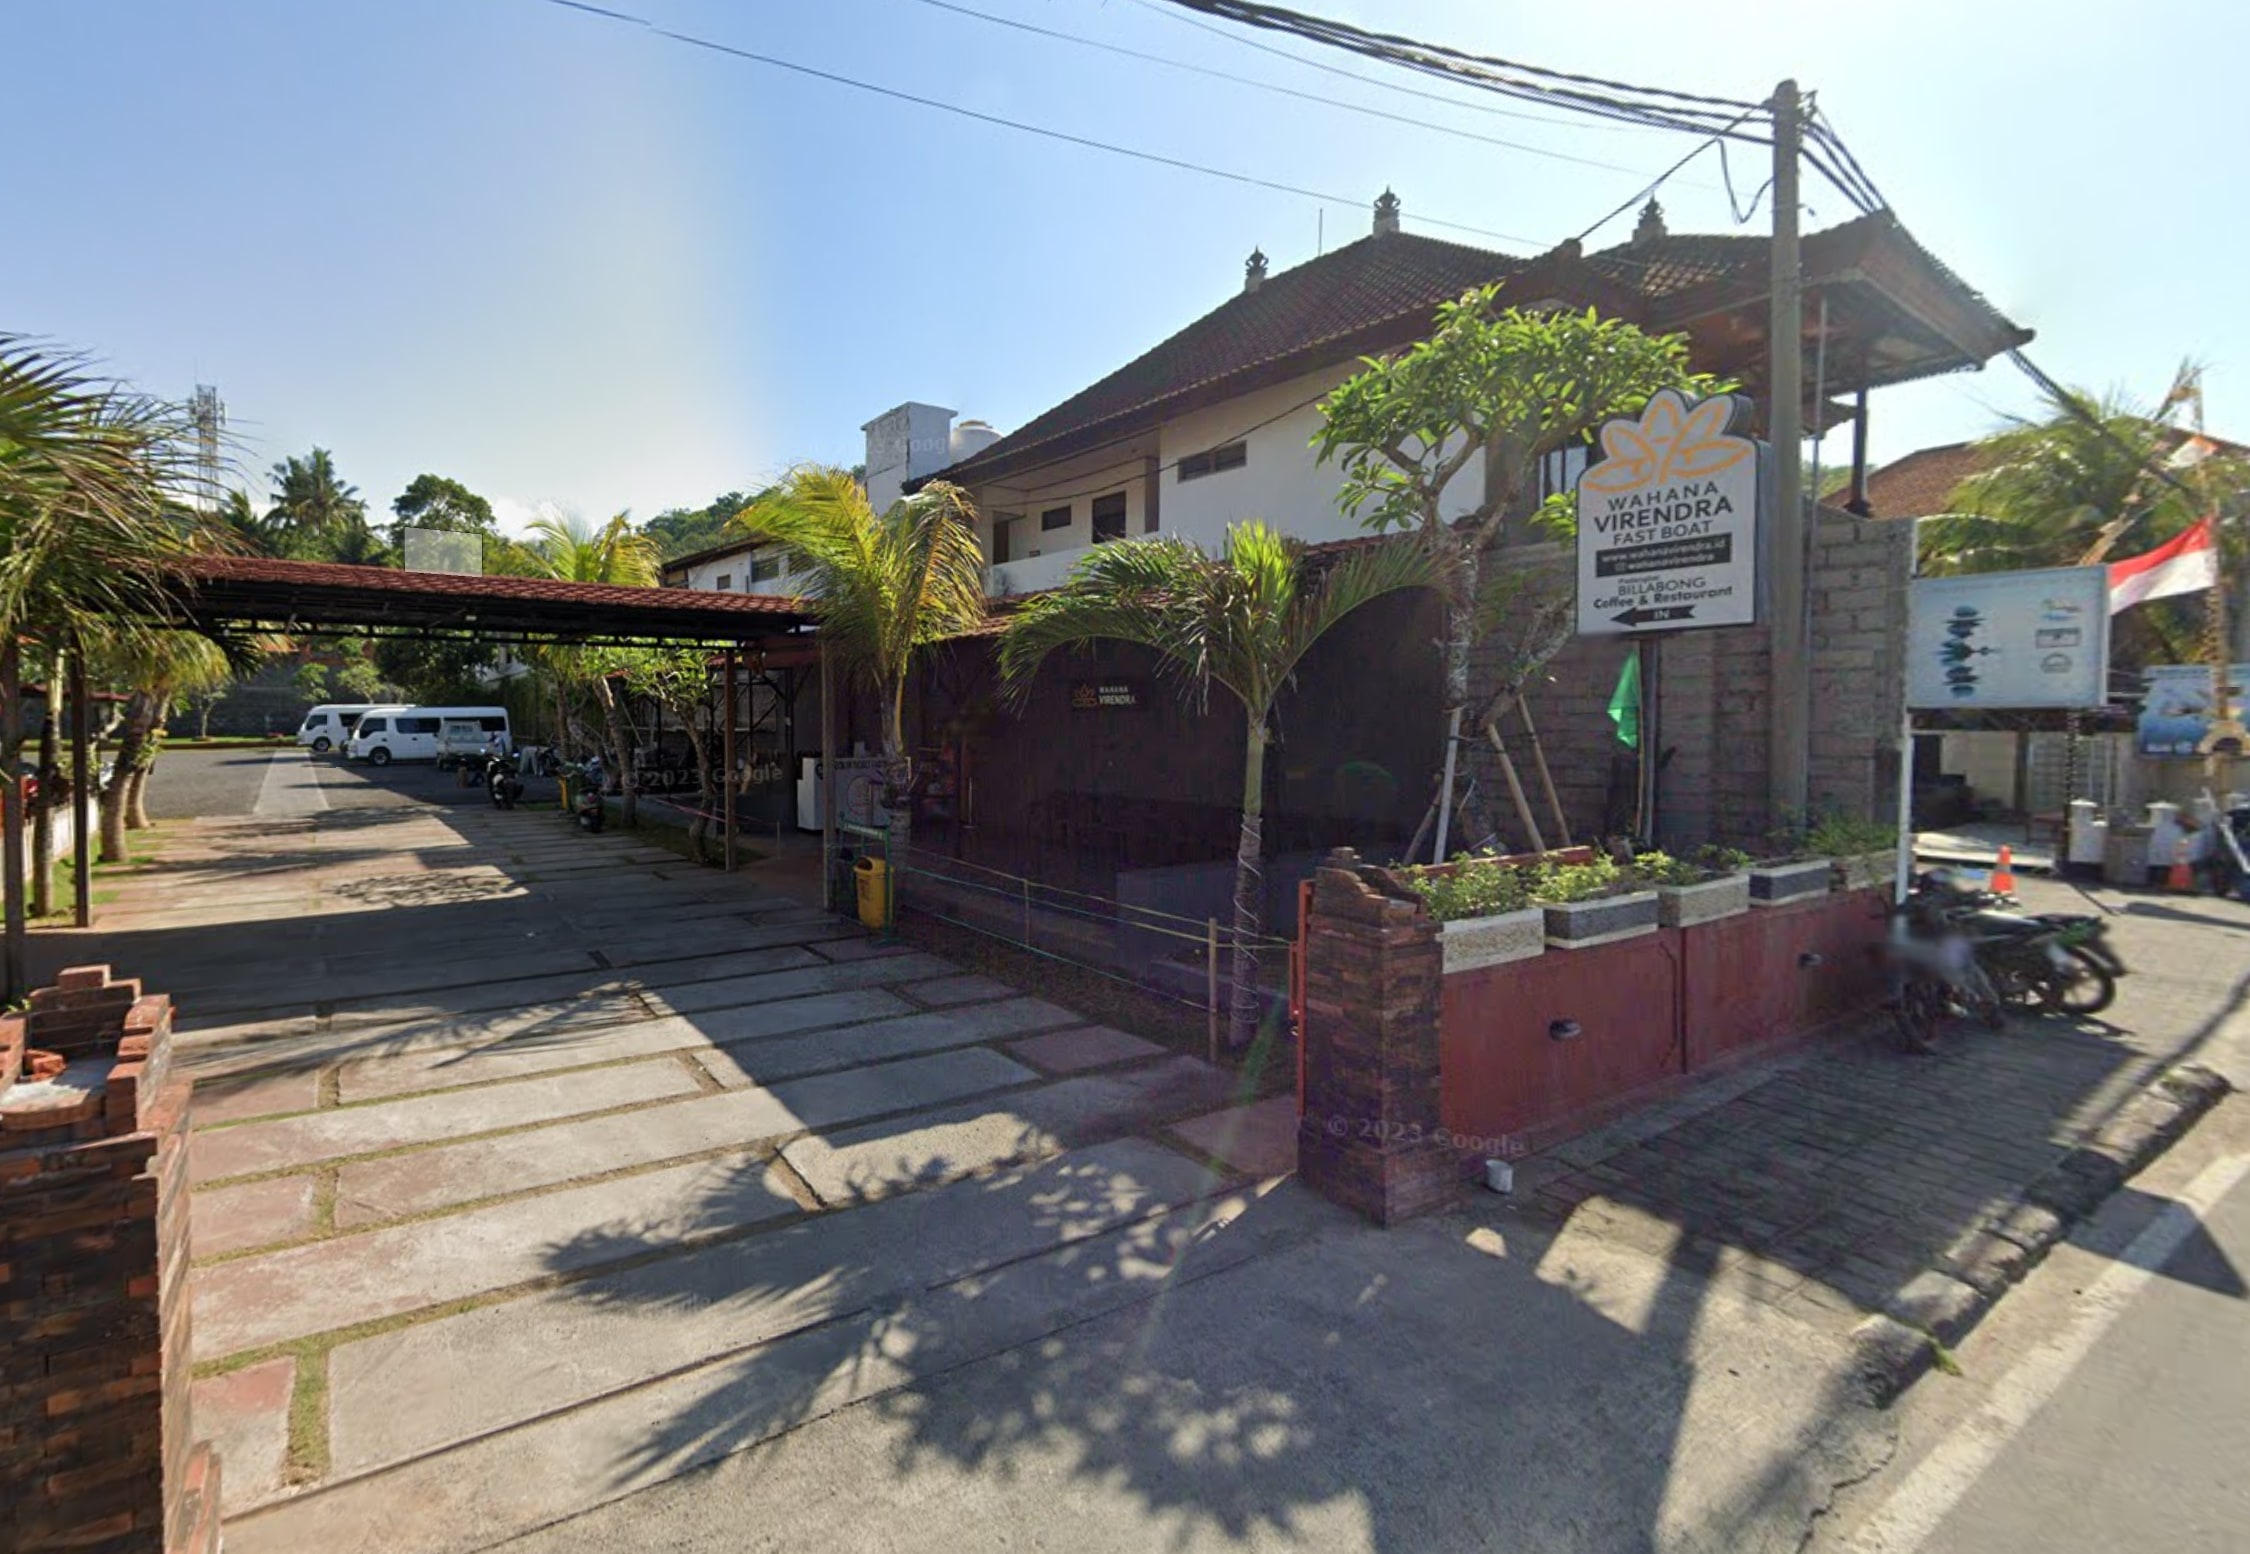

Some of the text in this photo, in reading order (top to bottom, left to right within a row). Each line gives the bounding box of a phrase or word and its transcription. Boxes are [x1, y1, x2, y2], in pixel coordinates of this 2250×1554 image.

[1607, 481, 1719, 512] WAHANA
[1594, 495, 1733, 532] VIRENDRA
[1613, 520, 1713, 546] FAST BOAT
[1593, 586, 1733, 610] Coffee & Restaurant
[1618, 577, 1706, 596] BILLABONG
[1654, 609, 1669, 619] IN
